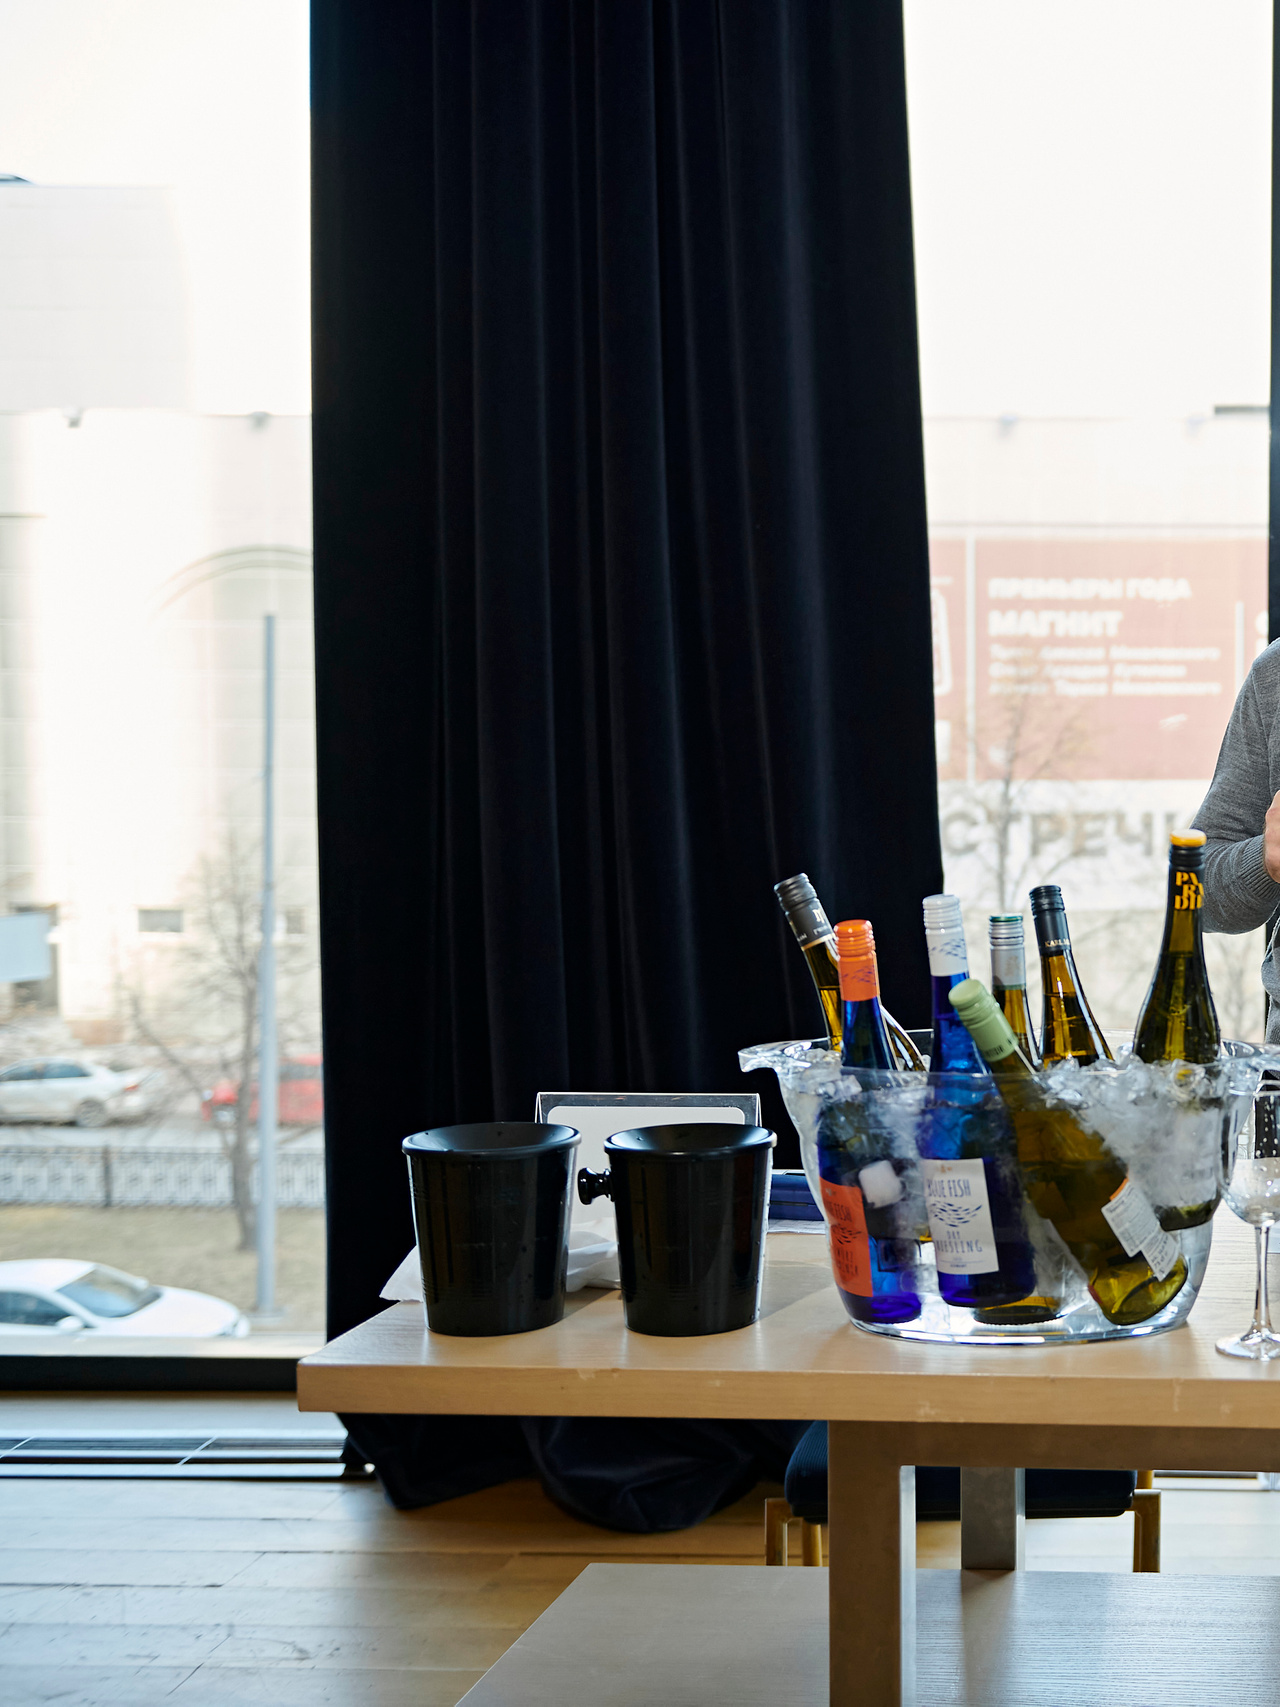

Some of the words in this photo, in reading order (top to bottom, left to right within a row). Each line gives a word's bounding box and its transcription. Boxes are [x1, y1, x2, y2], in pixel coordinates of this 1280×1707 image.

[1126, 578, 1192, 601] ГОДА
[988, 610, 1123, 637] МАГНИТ
[947, 1179, 972, 1198] FISH
